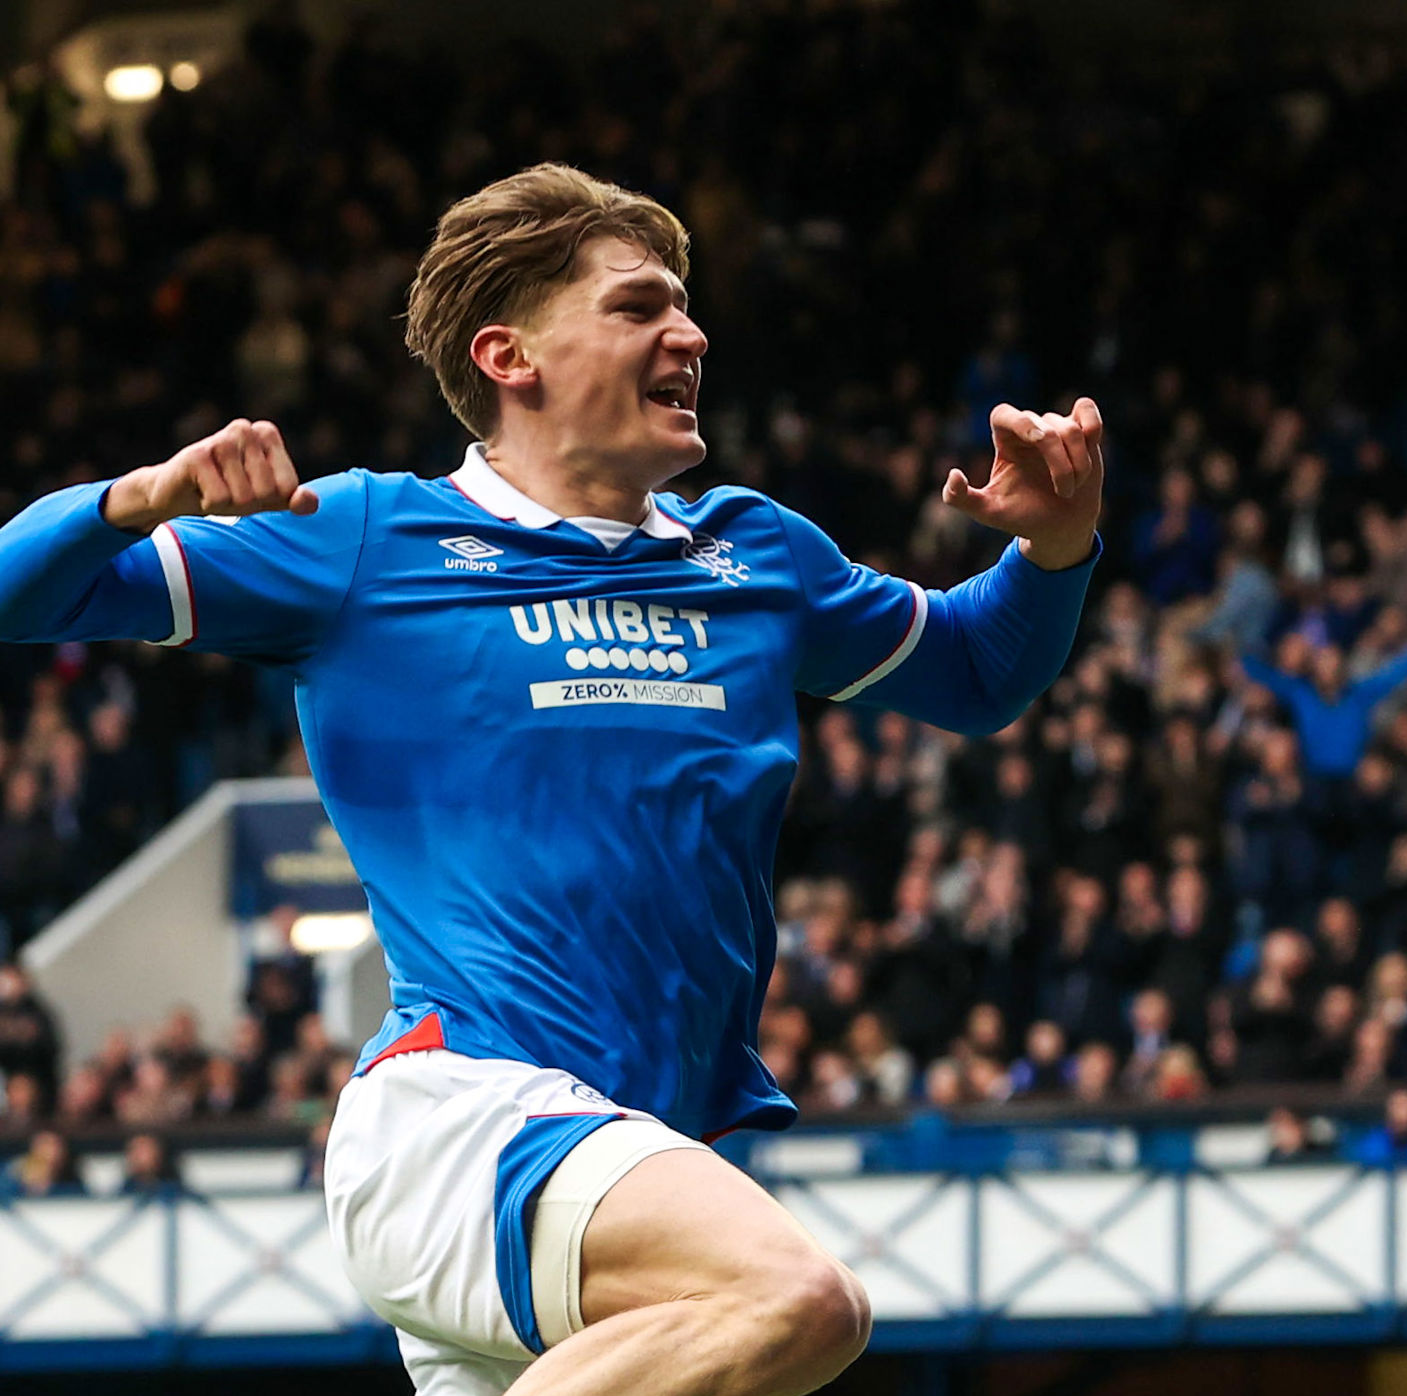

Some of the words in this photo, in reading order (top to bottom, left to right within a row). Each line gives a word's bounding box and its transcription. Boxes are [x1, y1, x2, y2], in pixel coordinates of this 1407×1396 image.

[444, 557, 498, 573] umbro
[509, 599, 709, 649] UNIBET
[561, 682, 629, 701] ZERO%
[633, 684, 703, 703] MISSION
